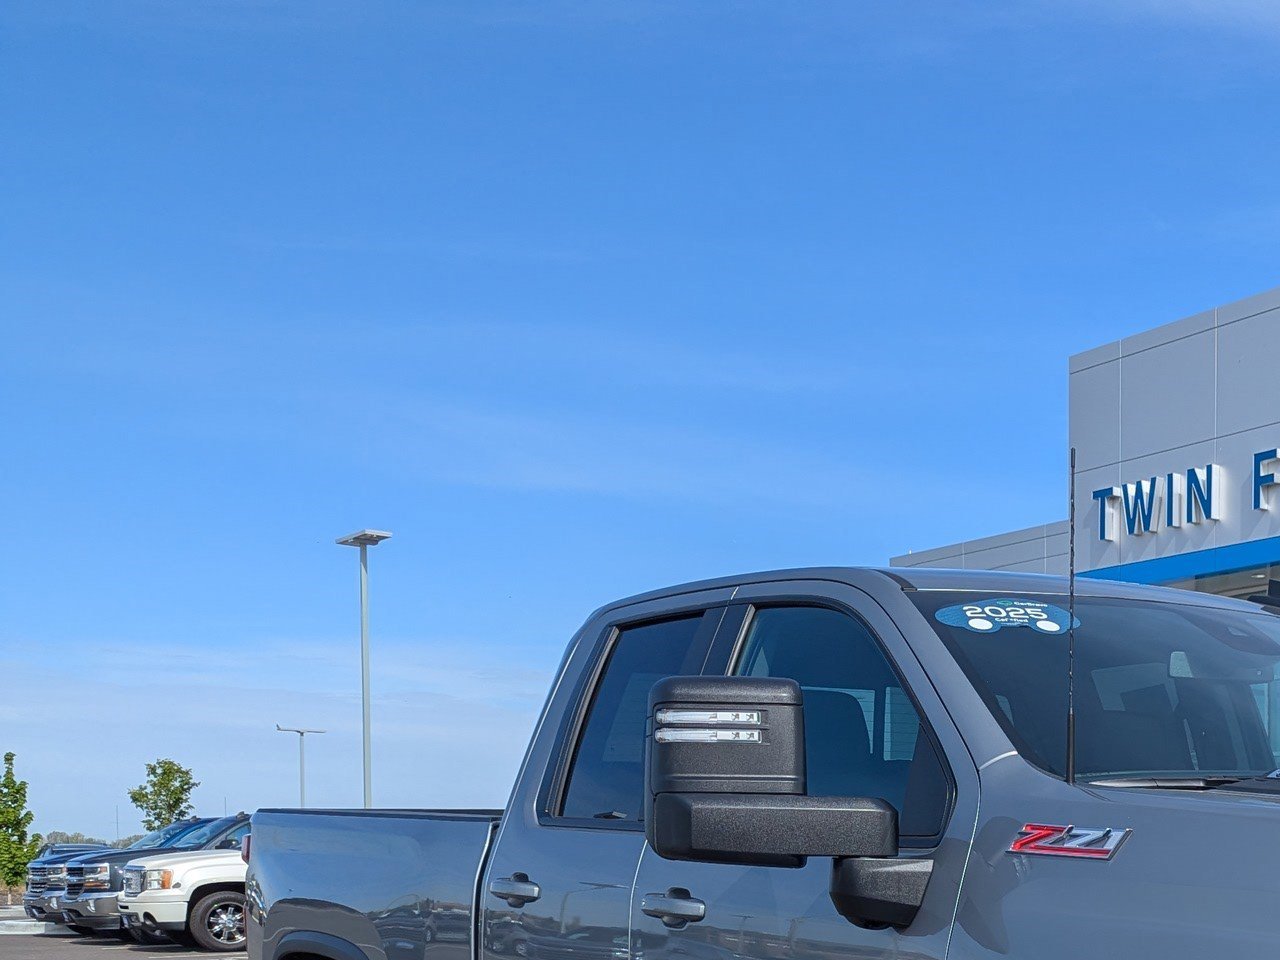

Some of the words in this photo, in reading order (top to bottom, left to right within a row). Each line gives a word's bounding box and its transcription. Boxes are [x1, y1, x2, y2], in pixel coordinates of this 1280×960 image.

[1092, 463, 1220, 542] TWIN
[962, 606, 1048, 620] 2025
[1006, 822, 1134, 861] Z71
